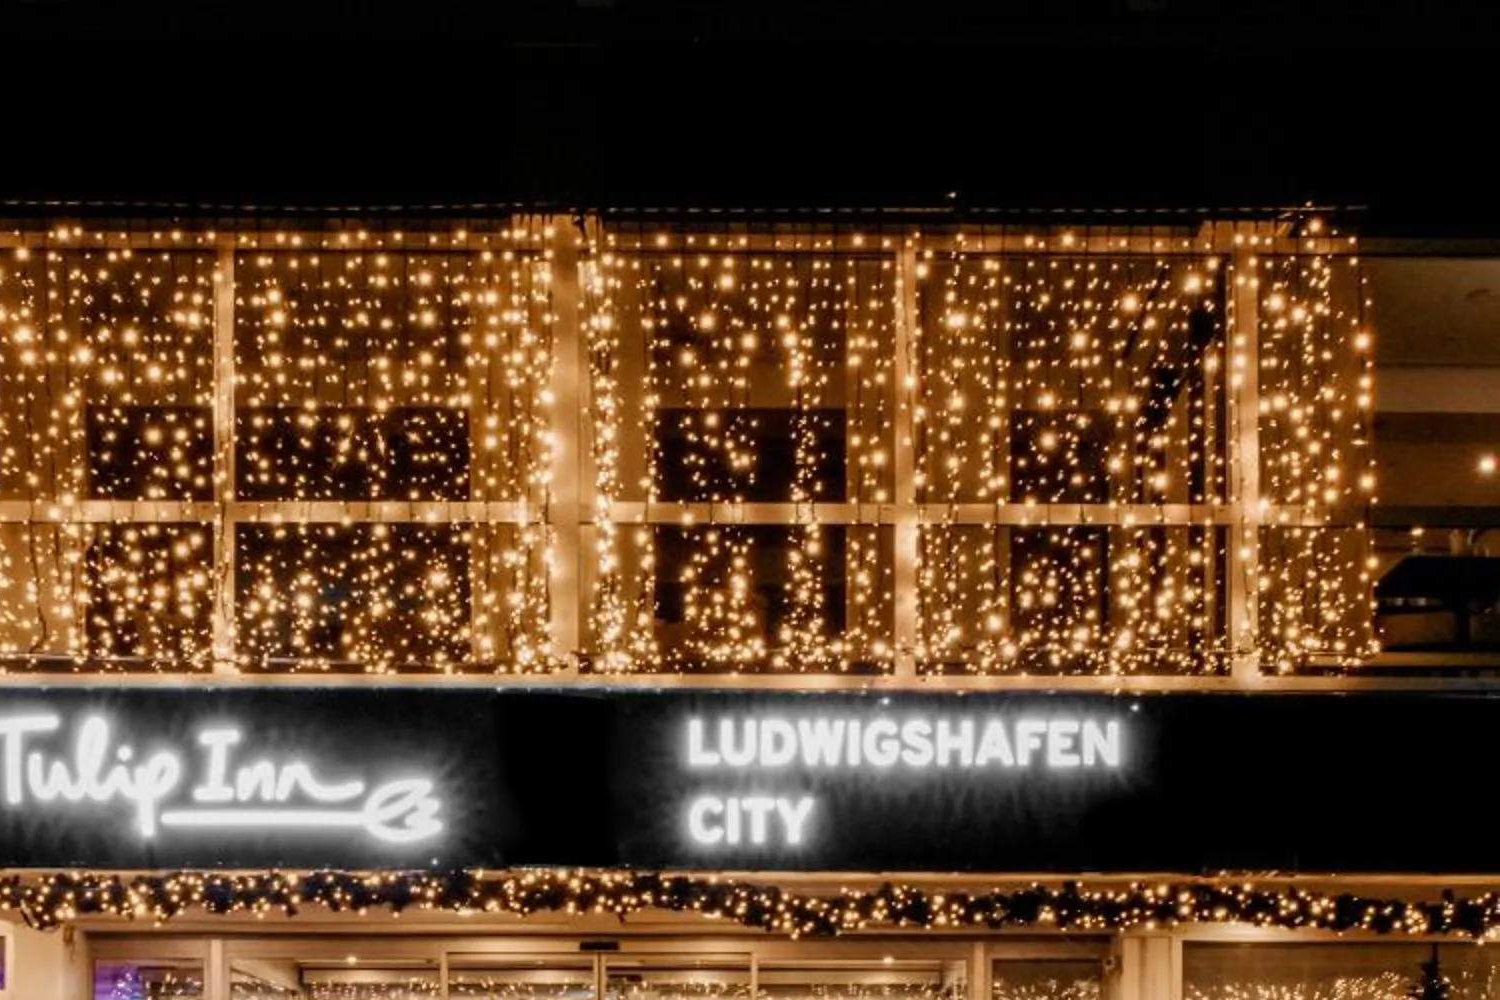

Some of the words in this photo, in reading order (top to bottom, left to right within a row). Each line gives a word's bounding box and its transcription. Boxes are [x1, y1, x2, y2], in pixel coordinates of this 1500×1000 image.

[192, 728, 365, 803] Inn
[687, 717, 1120, 768] LUDWIGSHAFEN
[687, 795, 815, 845] CITY
